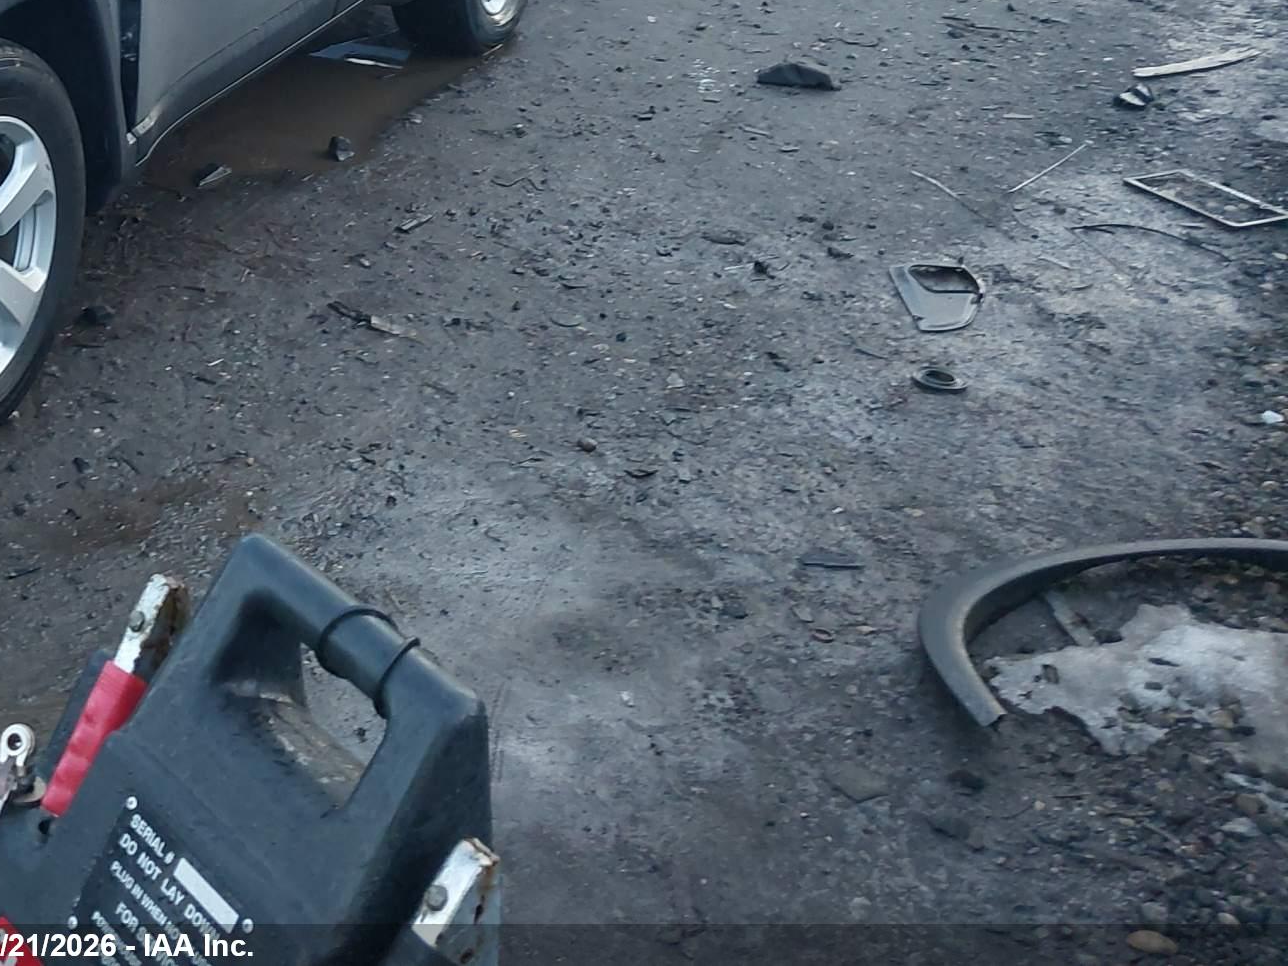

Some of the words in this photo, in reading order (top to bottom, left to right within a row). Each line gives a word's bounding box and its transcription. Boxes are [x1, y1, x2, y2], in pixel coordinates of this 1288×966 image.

[129, 813, 166, 858] SERIAL
[164, 850, 175, 865] #
[111, 861, 135, 890] PLUG
[131, 885, 144, 902] IN
[141, 893, 167, 926] WHEN
[118, 833, 138, 856] DO
[136, 851, 162, 882] NOT
[160, 878, 186, 906] LAY
[114, 901, 140, 933] FOR
